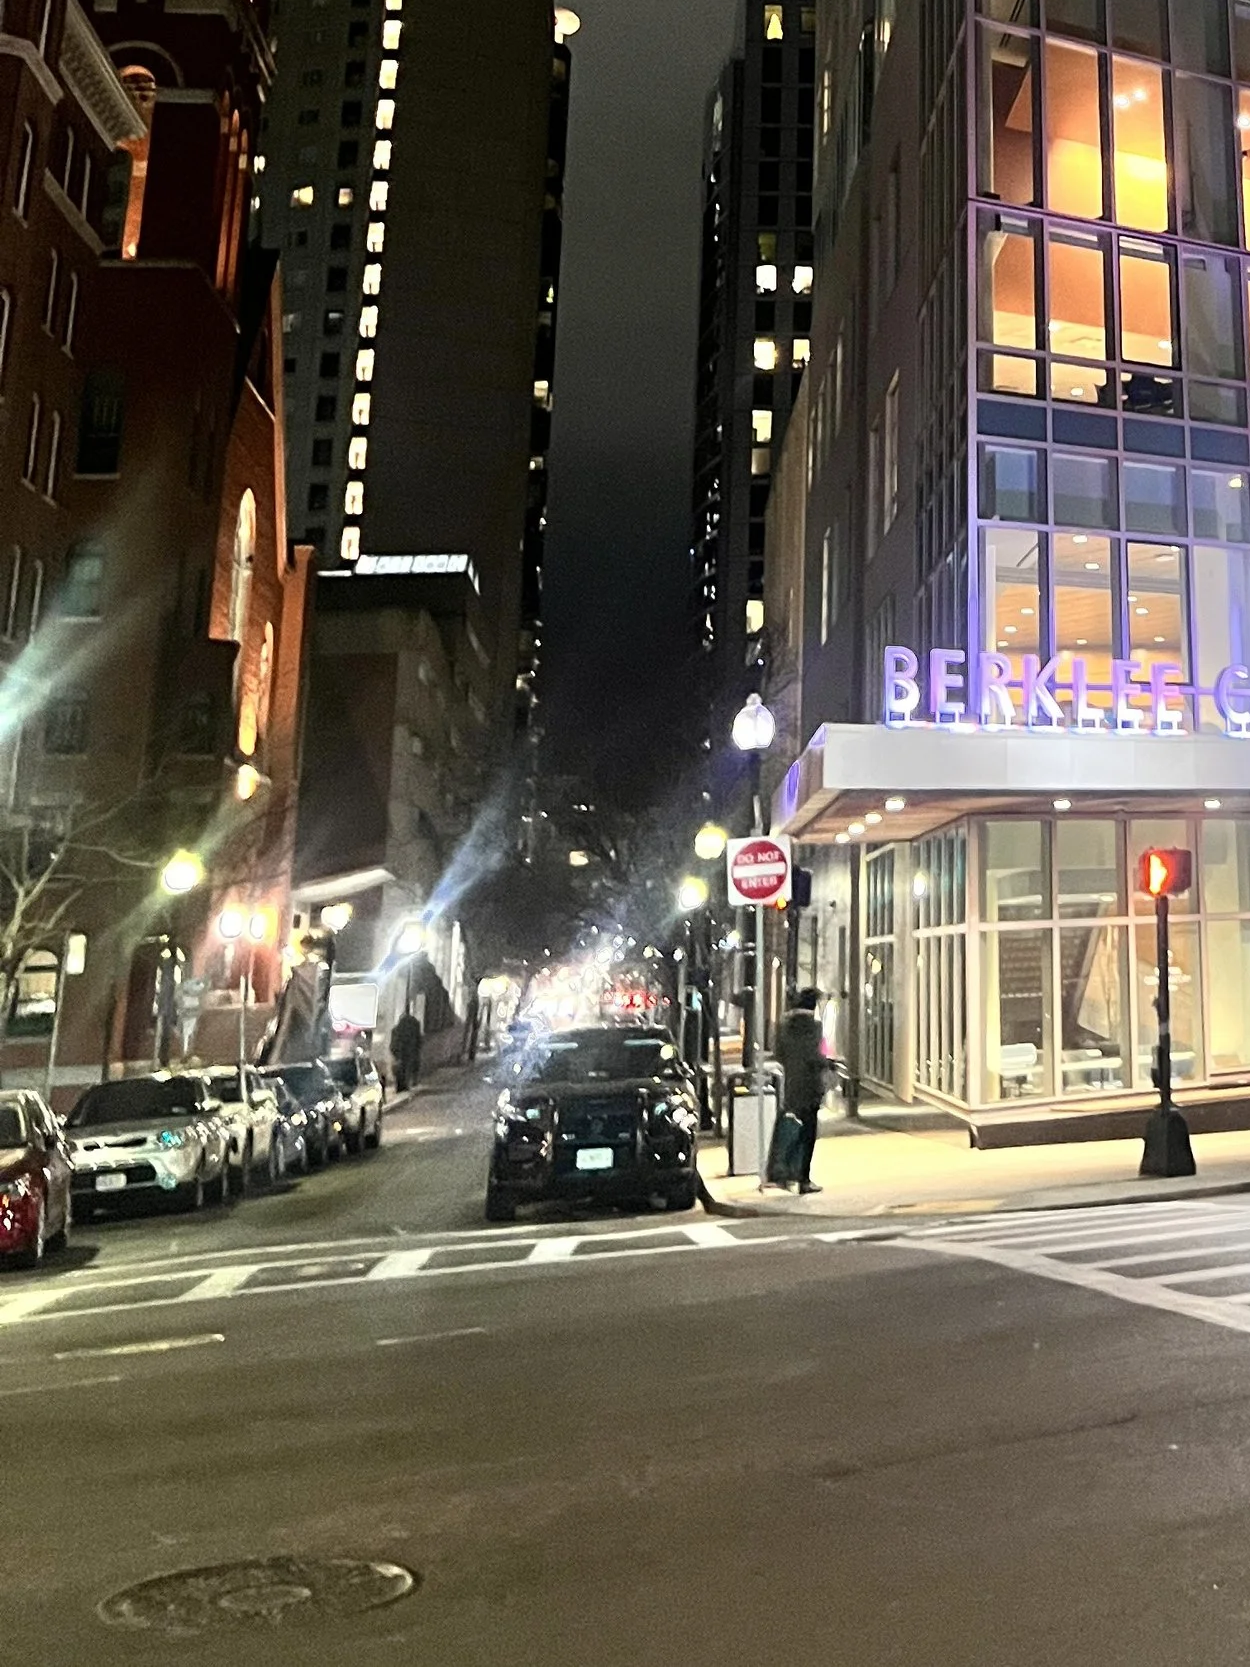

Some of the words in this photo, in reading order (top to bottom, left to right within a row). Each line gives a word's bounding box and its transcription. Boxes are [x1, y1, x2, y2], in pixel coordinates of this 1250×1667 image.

[885, 645, 1183, 723] BERKLEE
[736, 853, 755, 864] DO
[757, 850, 781, 863] NOT
[741, 876, 778, 890] ENTER
